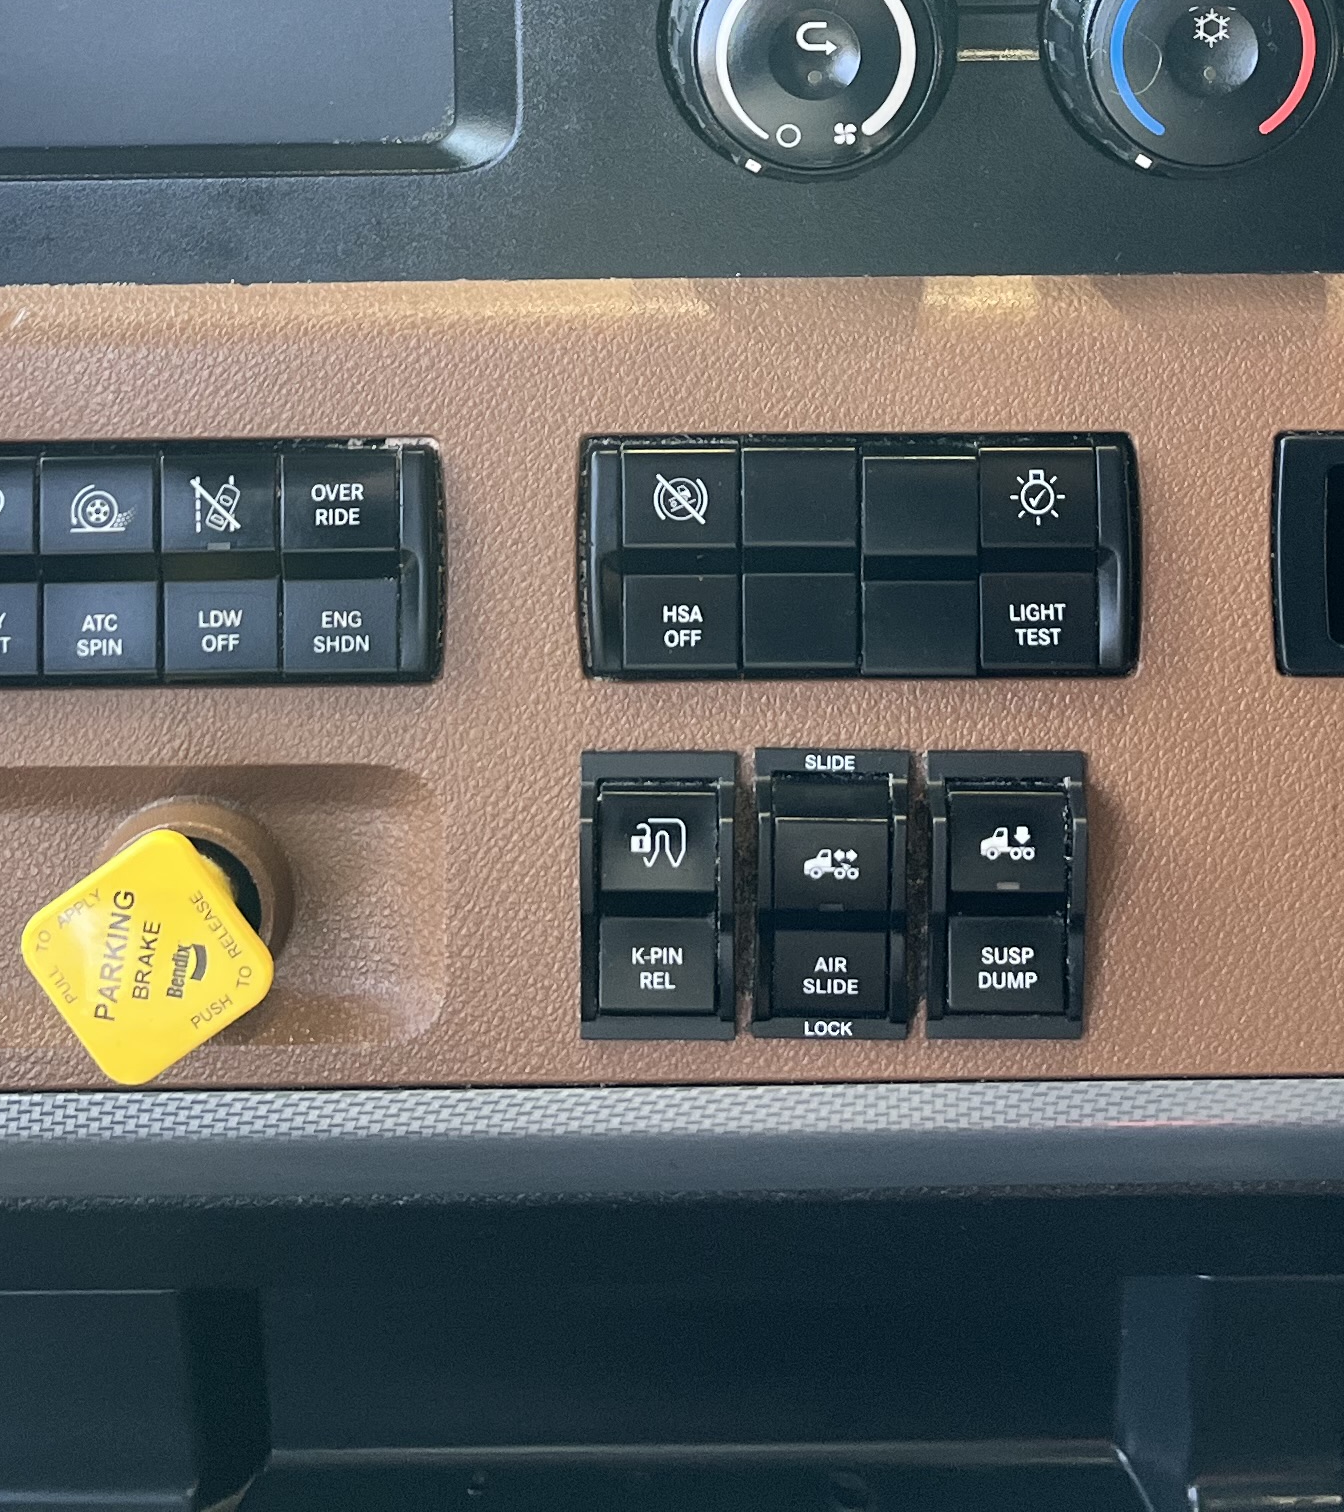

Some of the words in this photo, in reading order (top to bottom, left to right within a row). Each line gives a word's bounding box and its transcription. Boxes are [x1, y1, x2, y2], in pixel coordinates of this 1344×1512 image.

[311, 484, 363, 501] OVER
[316, 508, 360, 525] RIDE
[199, 610, 242, 627] LDW
[322, 611, 361, 628] ENG
[663, 605, 703, 622] HSA
[1010, 604, 1065, 621] LIGHT
[82, 614, 117, 631] ATC
[202, 634, 239, 652] OFF
[314, 635, 369, 652] SHDN
[664, 630, 701, 647] OFF
[1015, 628, 1061, 645] TEST
[77, 639, 122, 656] SPIN
[805, 755, 855, 772] SLIDE
[57, 888, 101, 929] APPLY
[190, 890, 241, 959] RELEASE
[35, 929, 52, 952] TO
[93, 890, 135, 1021] PARKING
[132, 920, 161, 1000] BRAKE
[632, 947, 682, 965] K-PIN
[982, 947, 1034, 964] SUSP
[166, 944, 192, 999] Bendix
[815, 957, 846, 972] AIR
[48, 964, 78, 1004] PULL
[236, 966, 252, 988] TO
[640, 972, 675, 989] REL
[979, 972, 1037, 989] DUMP
[803, 979, 858, 994] SLIDE
[190, 994, 233, 1029] PUSH
[805, 1021, 852, 1036] LOCK
